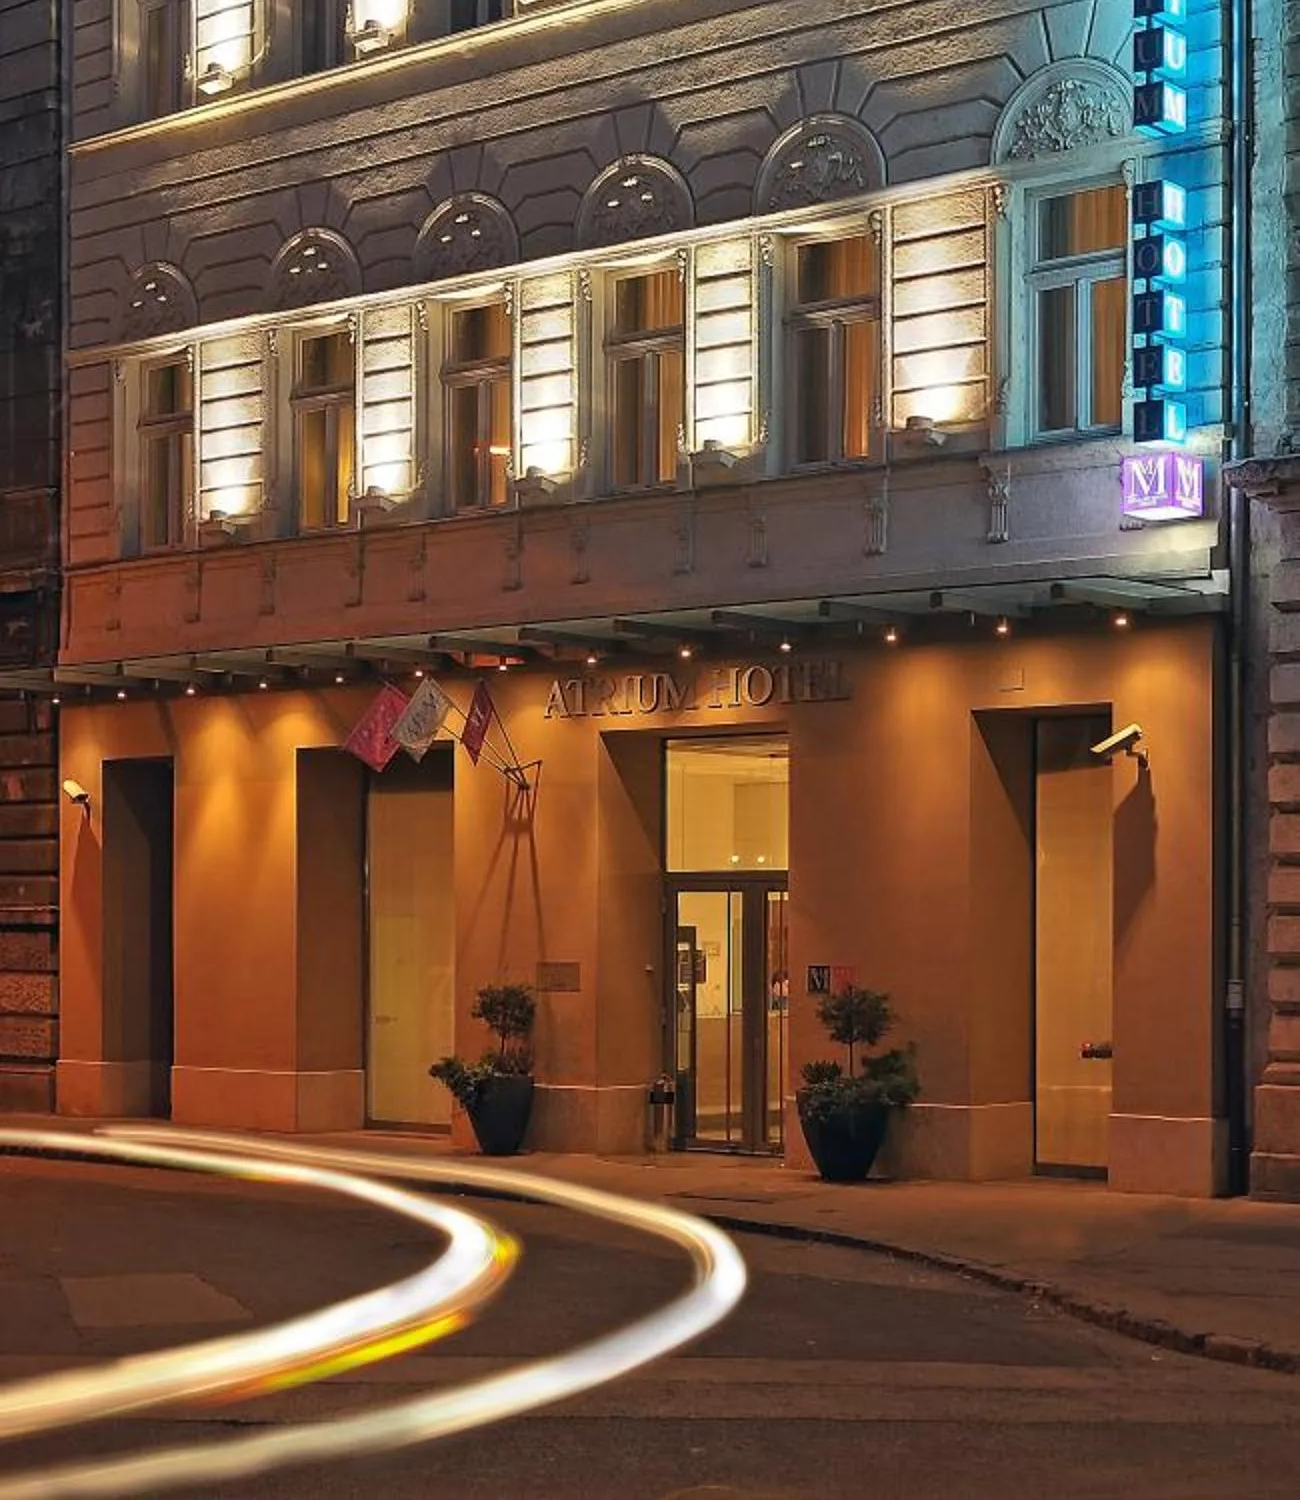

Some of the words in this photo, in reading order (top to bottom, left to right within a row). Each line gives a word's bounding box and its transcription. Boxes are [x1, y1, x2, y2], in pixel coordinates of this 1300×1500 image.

[1136, 187, 1162, 437] HOTEL
[544, 672, 699, 719] ATRIUM
[707, 660, 850, 709] HOTEL
